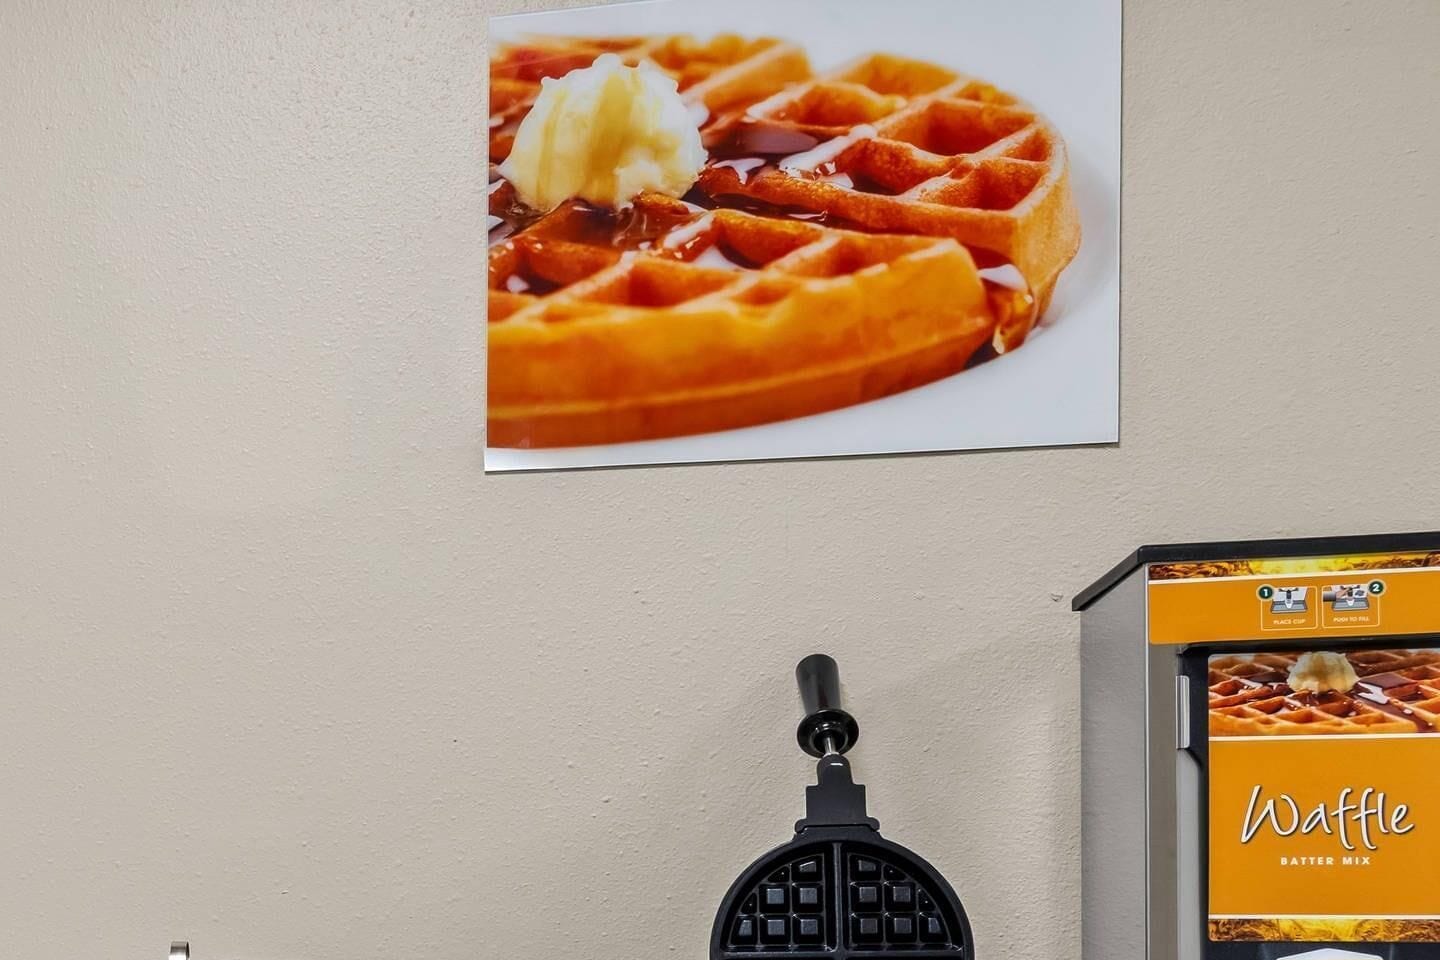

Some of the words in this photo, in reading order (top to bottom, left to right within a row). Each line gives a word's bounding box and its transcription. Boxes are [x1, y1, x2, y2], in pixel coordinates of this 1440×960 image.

[1372, 583, 1380, 592] 2
[1263, 588, 1269, 597] 1
[1240, 784, 1415, 850] Waffle
[1280, 856, 1334, 866] BATTER
[1342, 856, 1370, 866] MIX
